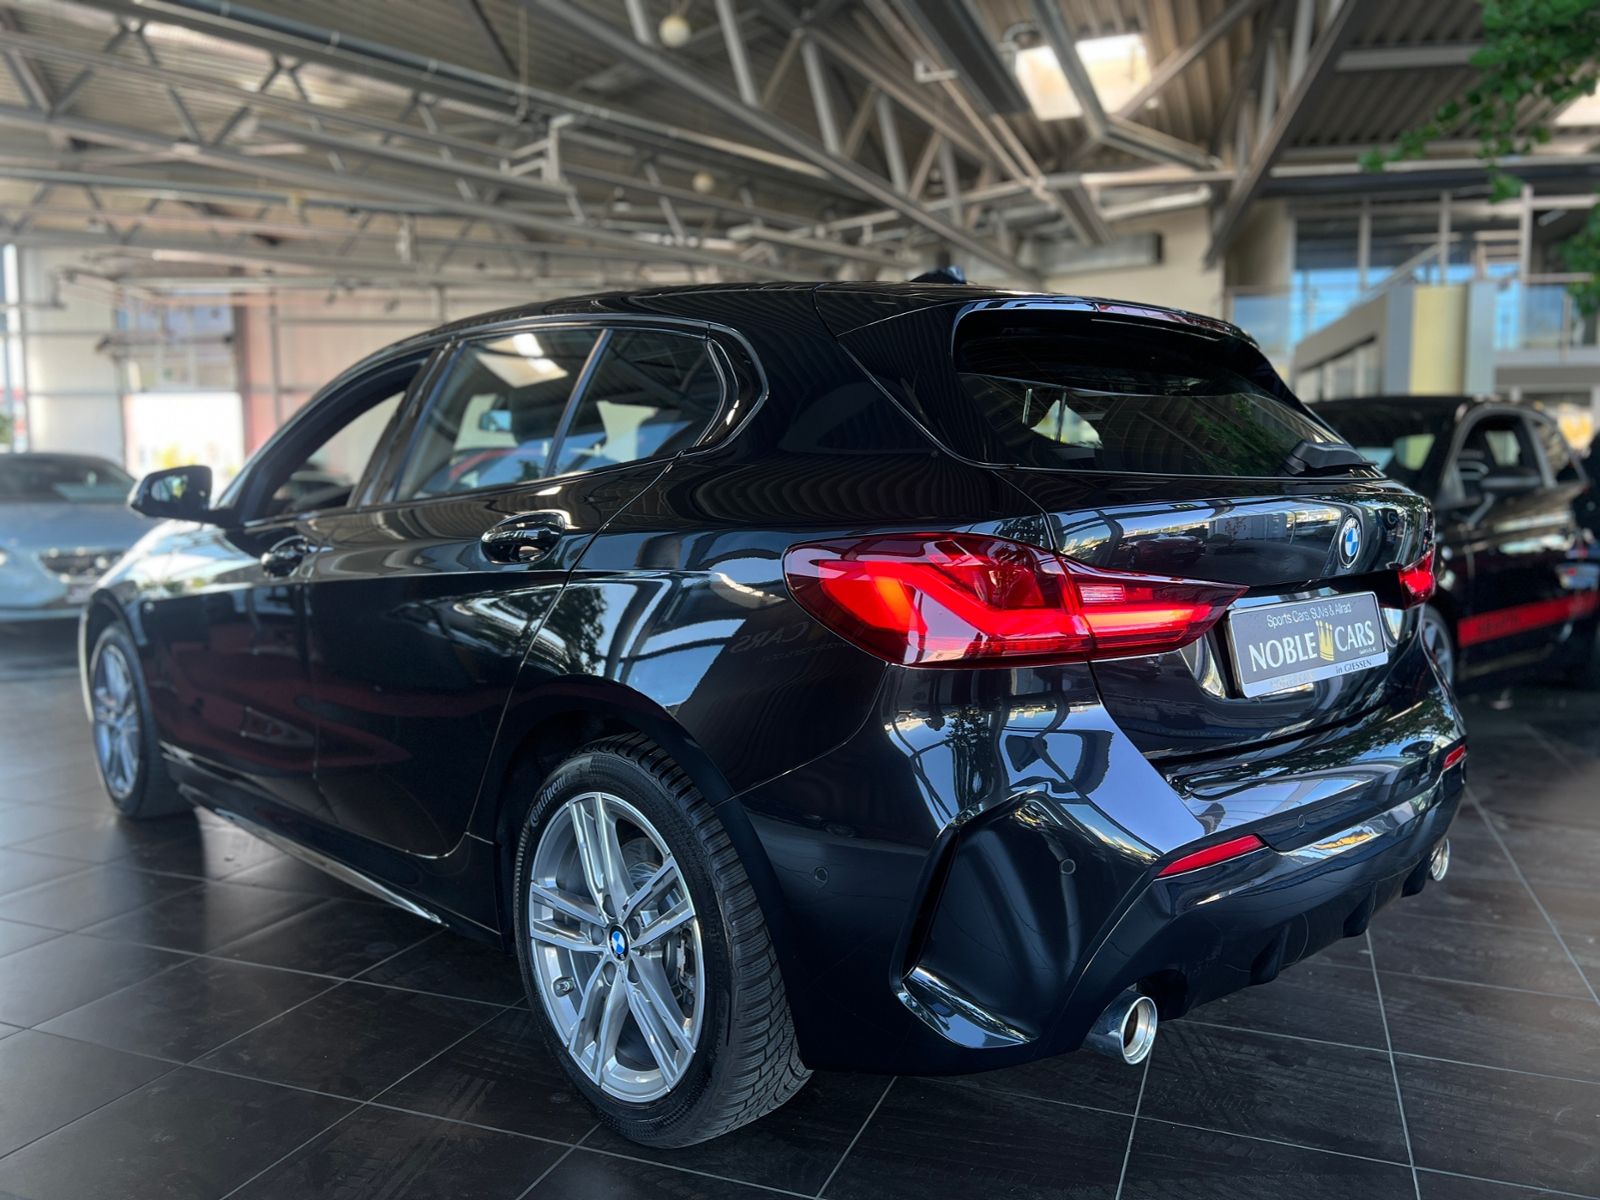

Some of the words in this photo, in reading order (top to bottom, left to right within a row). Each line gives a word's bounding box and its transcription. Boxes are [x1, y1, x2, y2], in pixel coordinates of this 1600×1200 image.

[1266, 613, 1292, 628] Sports
[1328, 604, 1335, 616] &
[1248, 631, 1319, 672] NOBLE
[1334, 620, 1375, 652] CARS
[1335, 665, 1343, 675] in
[1344, 659, 1373, 673] GIESSEN
[530, 772, 572, 827] Continent
